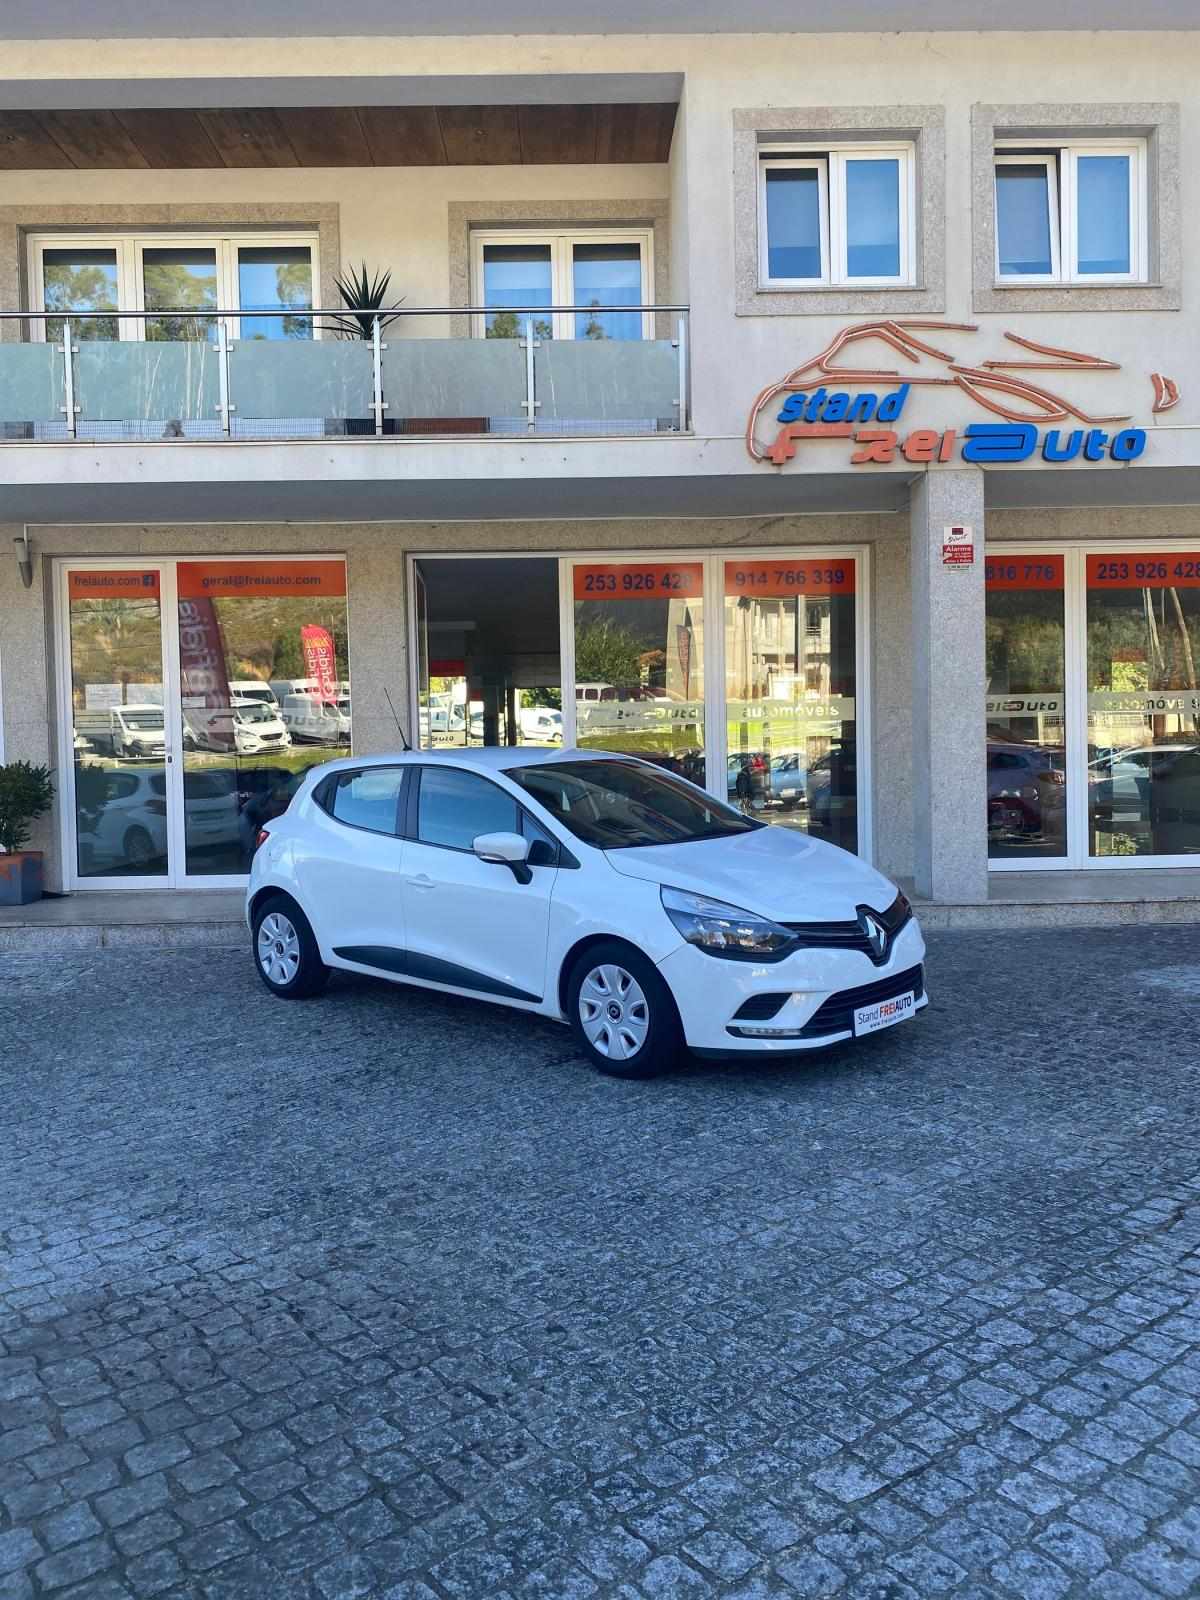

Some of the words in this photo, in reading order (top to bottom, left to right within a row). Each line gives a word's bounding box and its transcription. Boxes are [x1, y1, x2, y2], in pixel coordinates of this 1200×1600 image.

[777, 384, 910, 423] stand
[736, 571, 767, 586] 914
[774, 571, 806, 586] 766
[812, 569, 845, 585] 339
[1023, 565, 1056, 580] 776
[1097, 563, 1130, 580] 253
[1136, 562, 1168, 579] 926
[1173, 562, 1200, 578] 428
[75, 575, 140, 587] freiauto.com
[202, 575, 321, 587] geral@freiauto.com
[585, 574, 617, 592] 253
[623, 573, 655, 591] 926
[858, 1008, 878, 1024] Stand
[879, 995, 912, 1018] FREIAUTO
